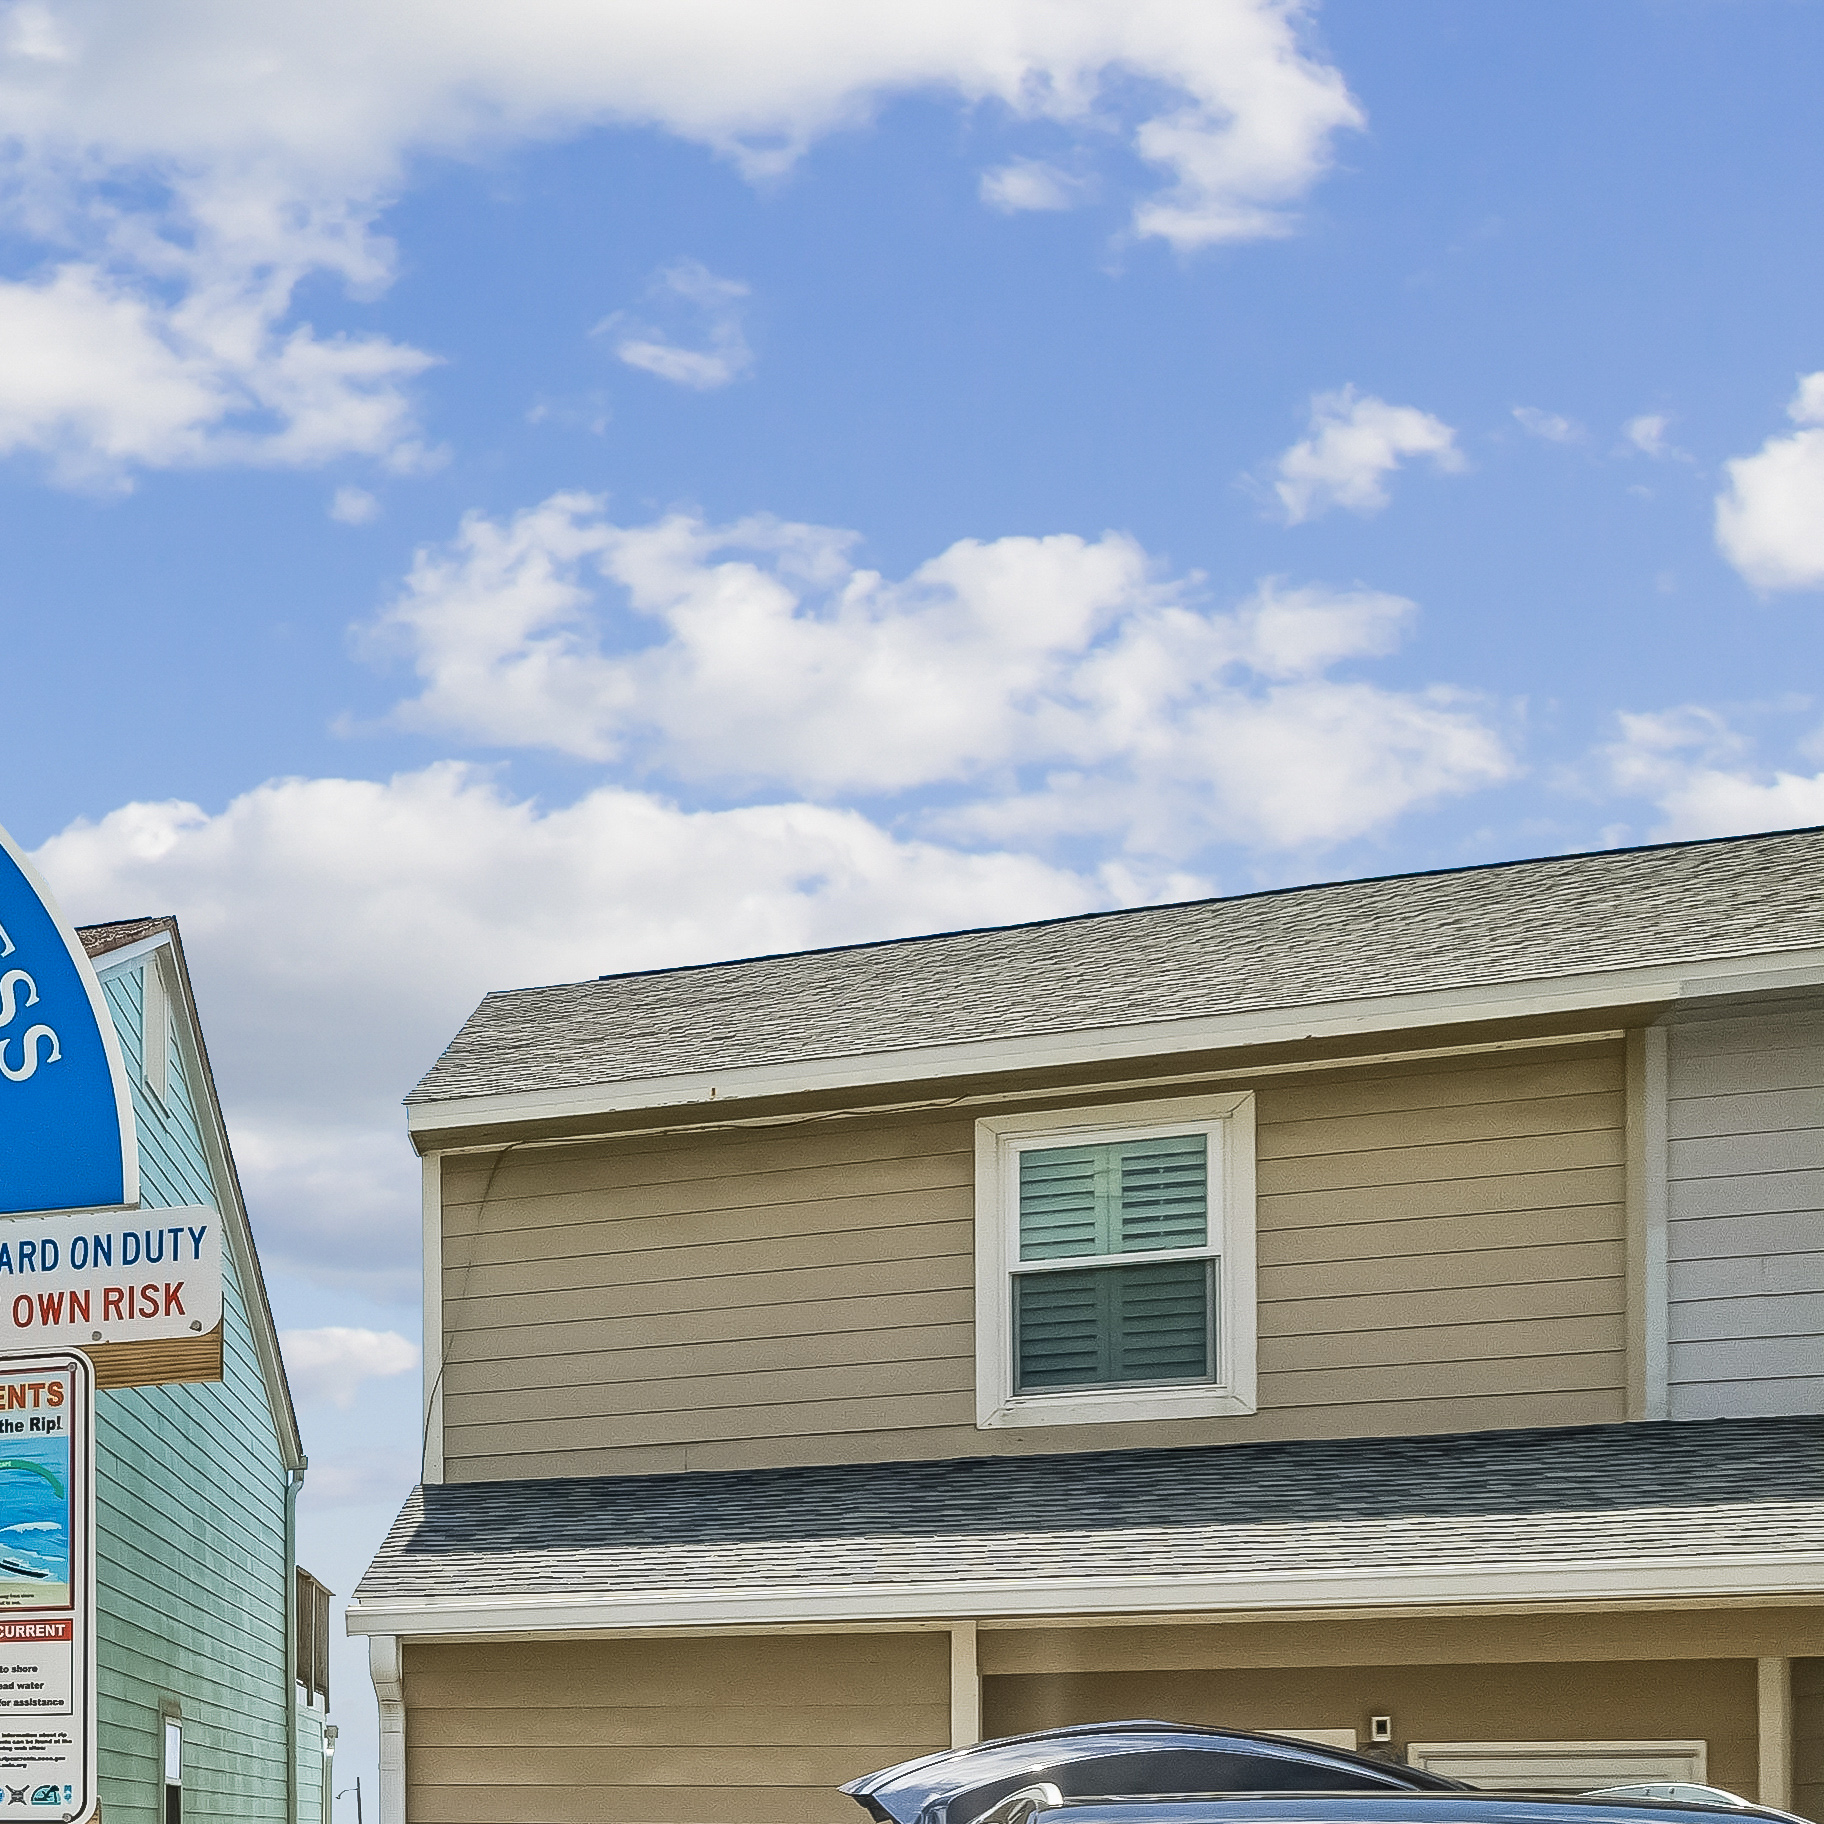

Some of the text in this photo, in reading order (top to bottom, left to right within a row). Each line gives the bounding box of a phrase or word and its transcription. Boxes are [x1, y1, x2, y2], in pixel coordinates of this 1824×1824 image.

[71, 1234, 111, 1270] ON
[123, 1226, 207, 1265] DUTY
[12, 1291, 90, 1328] OWN
[103, 1282, 185, 1321] RISK
[30, 1416, 63, 1434] Rip!
